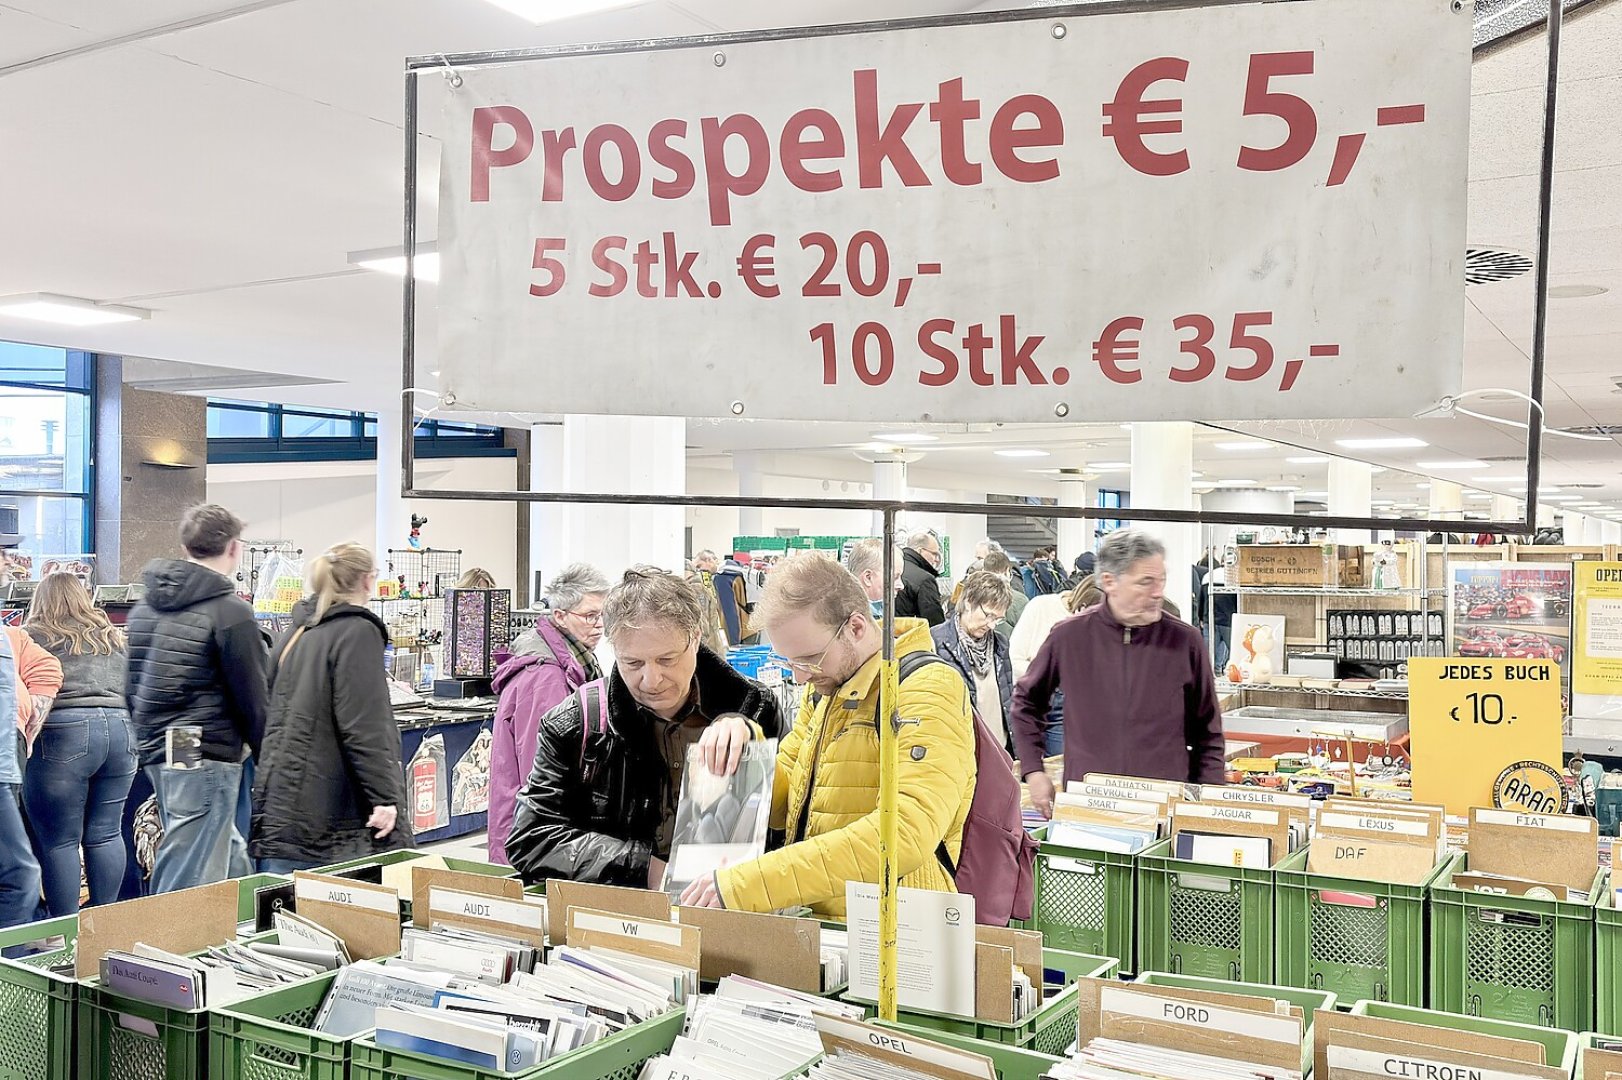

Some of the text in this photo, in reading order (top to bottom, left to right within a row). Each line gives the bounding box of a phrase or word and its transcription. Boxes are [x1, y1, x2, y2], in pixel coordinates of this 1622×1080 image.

[470, 50, 1425, 226] Prospekte € 5,-
[529, 230, 942, 308] 5 Stk. € 20,-
[809, 311, 1340, 392] 10 Stk. € 35,-
[1439, 665, 1550, 681] JEDES BUCH
[1449, 706, 1460, 721] €
[1085, 785, 1138, 799] CHEVROLET
[1222, 791, 1275, 803] CHRYSLER
[1503, 777, 1556, 814] ARAG
[1087, 798, 1119, 810] SMART
[1211, 807, 1252, 820] JAGUAR
[1516, 815, 1546, 827] FIAT
[1358, 818, 1395, 831] LEXUS
[1334, 846, 1367, 860] DAF
[328, 890, 353, 904] AUDI
[463, 902, 491, 917] AUDI
[621, 921, 639, 936] VW
[1163, 1003, 1209, 1023] FORD
[869, 1032, 913, 1055] OPEL
[1384, 1058, 1482, 1080] CITROEN
